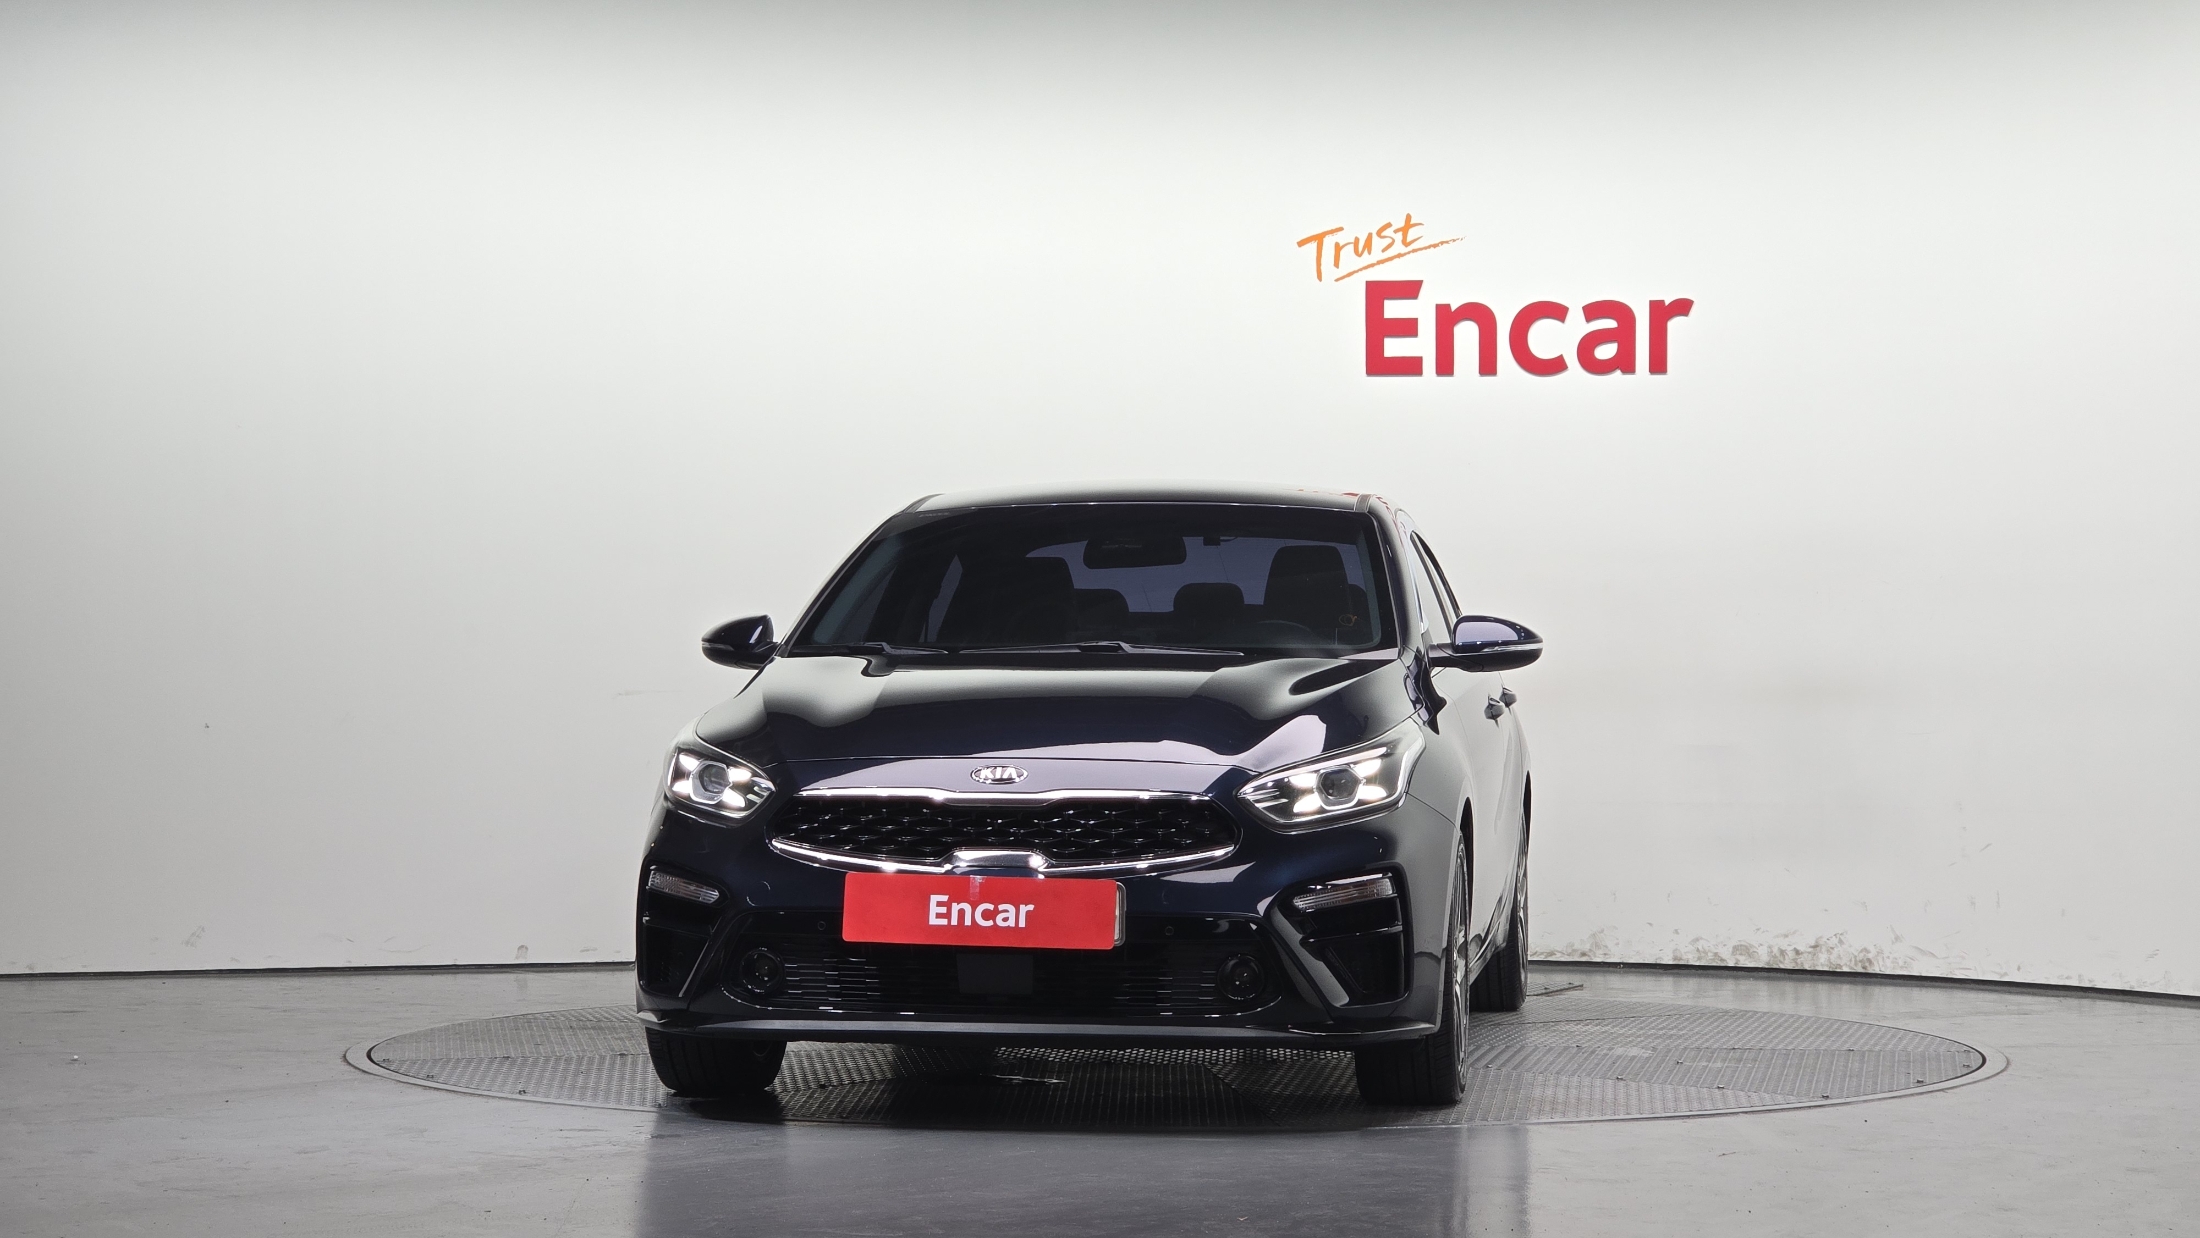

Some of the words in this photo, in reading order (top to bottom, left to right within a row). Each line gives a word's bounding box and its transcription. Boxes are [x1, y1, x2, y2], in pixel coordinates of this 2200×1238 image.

[1297, 213, 1424, 282] Trust
[1365, 280, 1694, 376] Encar
[980, 766, 1018, 779] KIA
[928, 894, 1035, 928] Encar
